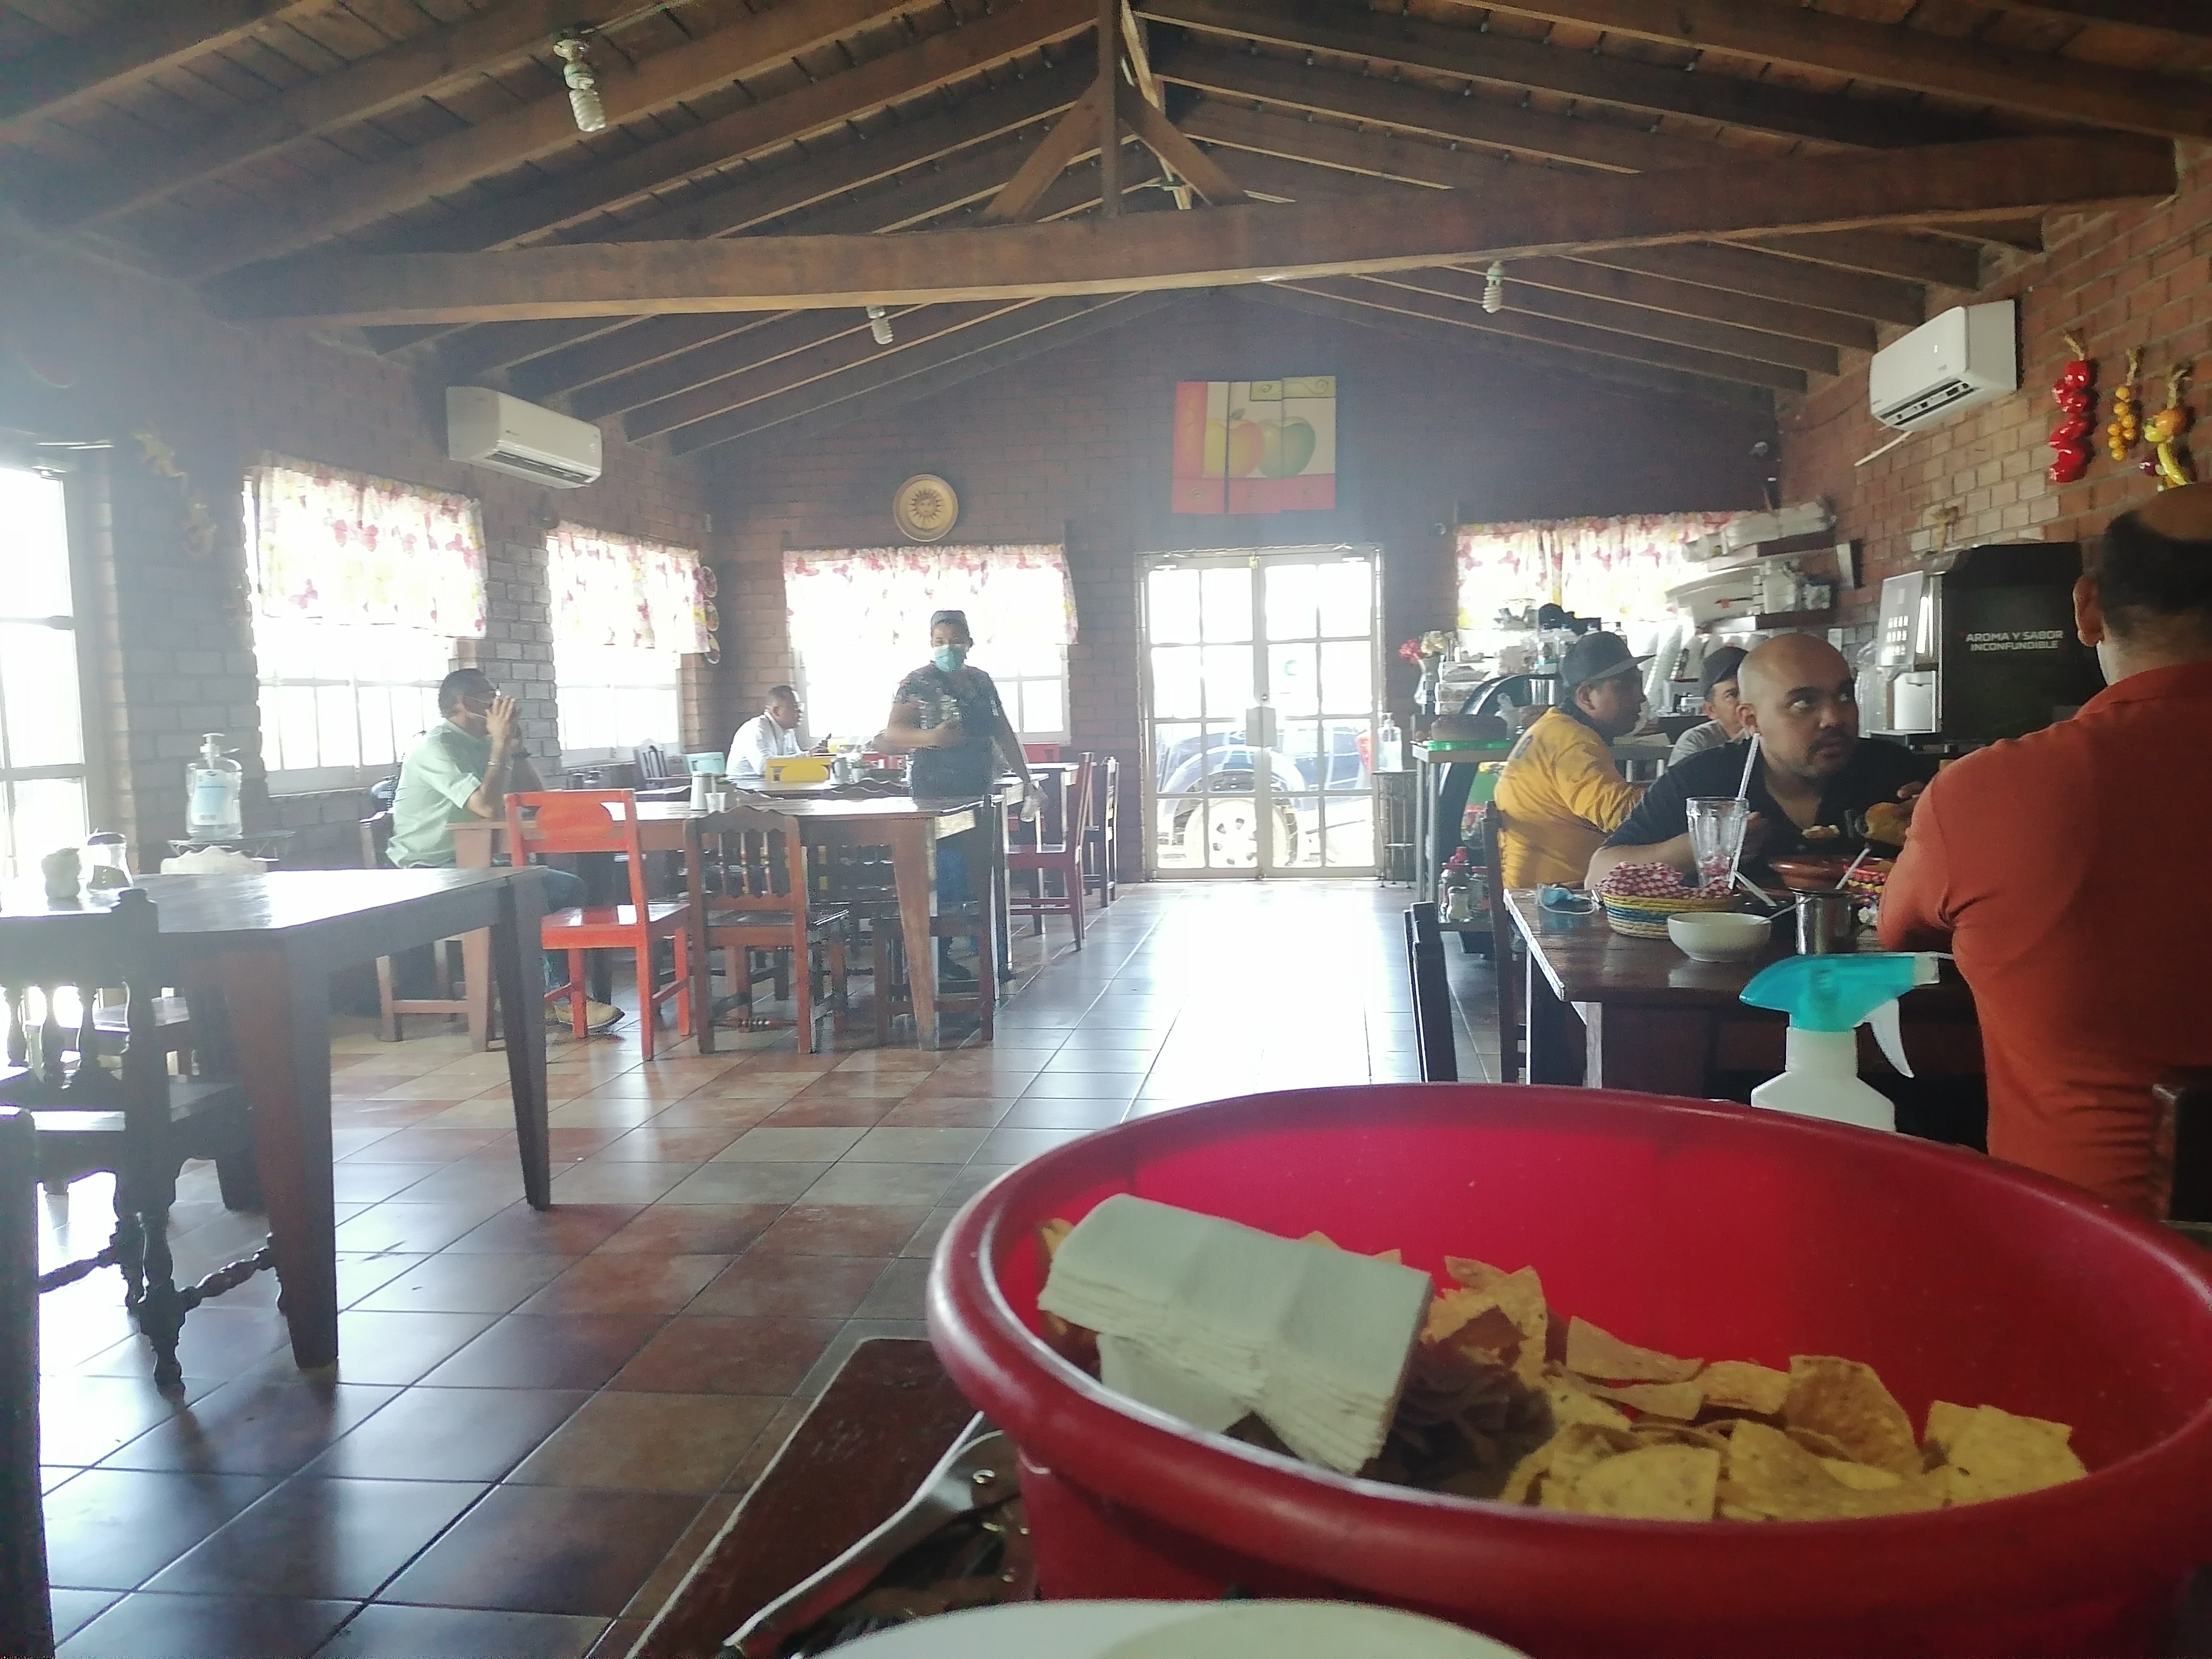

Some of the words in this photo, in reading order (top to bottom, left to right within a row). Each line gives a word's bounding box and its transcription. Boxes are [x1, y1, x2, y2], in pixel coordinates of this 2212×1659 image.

[1966, 633, 2010, 642] AROMA
[2022, 630, 2063, 640] SABOR
[1970, 640, 2059, 651] INCONFUNDIBLE
